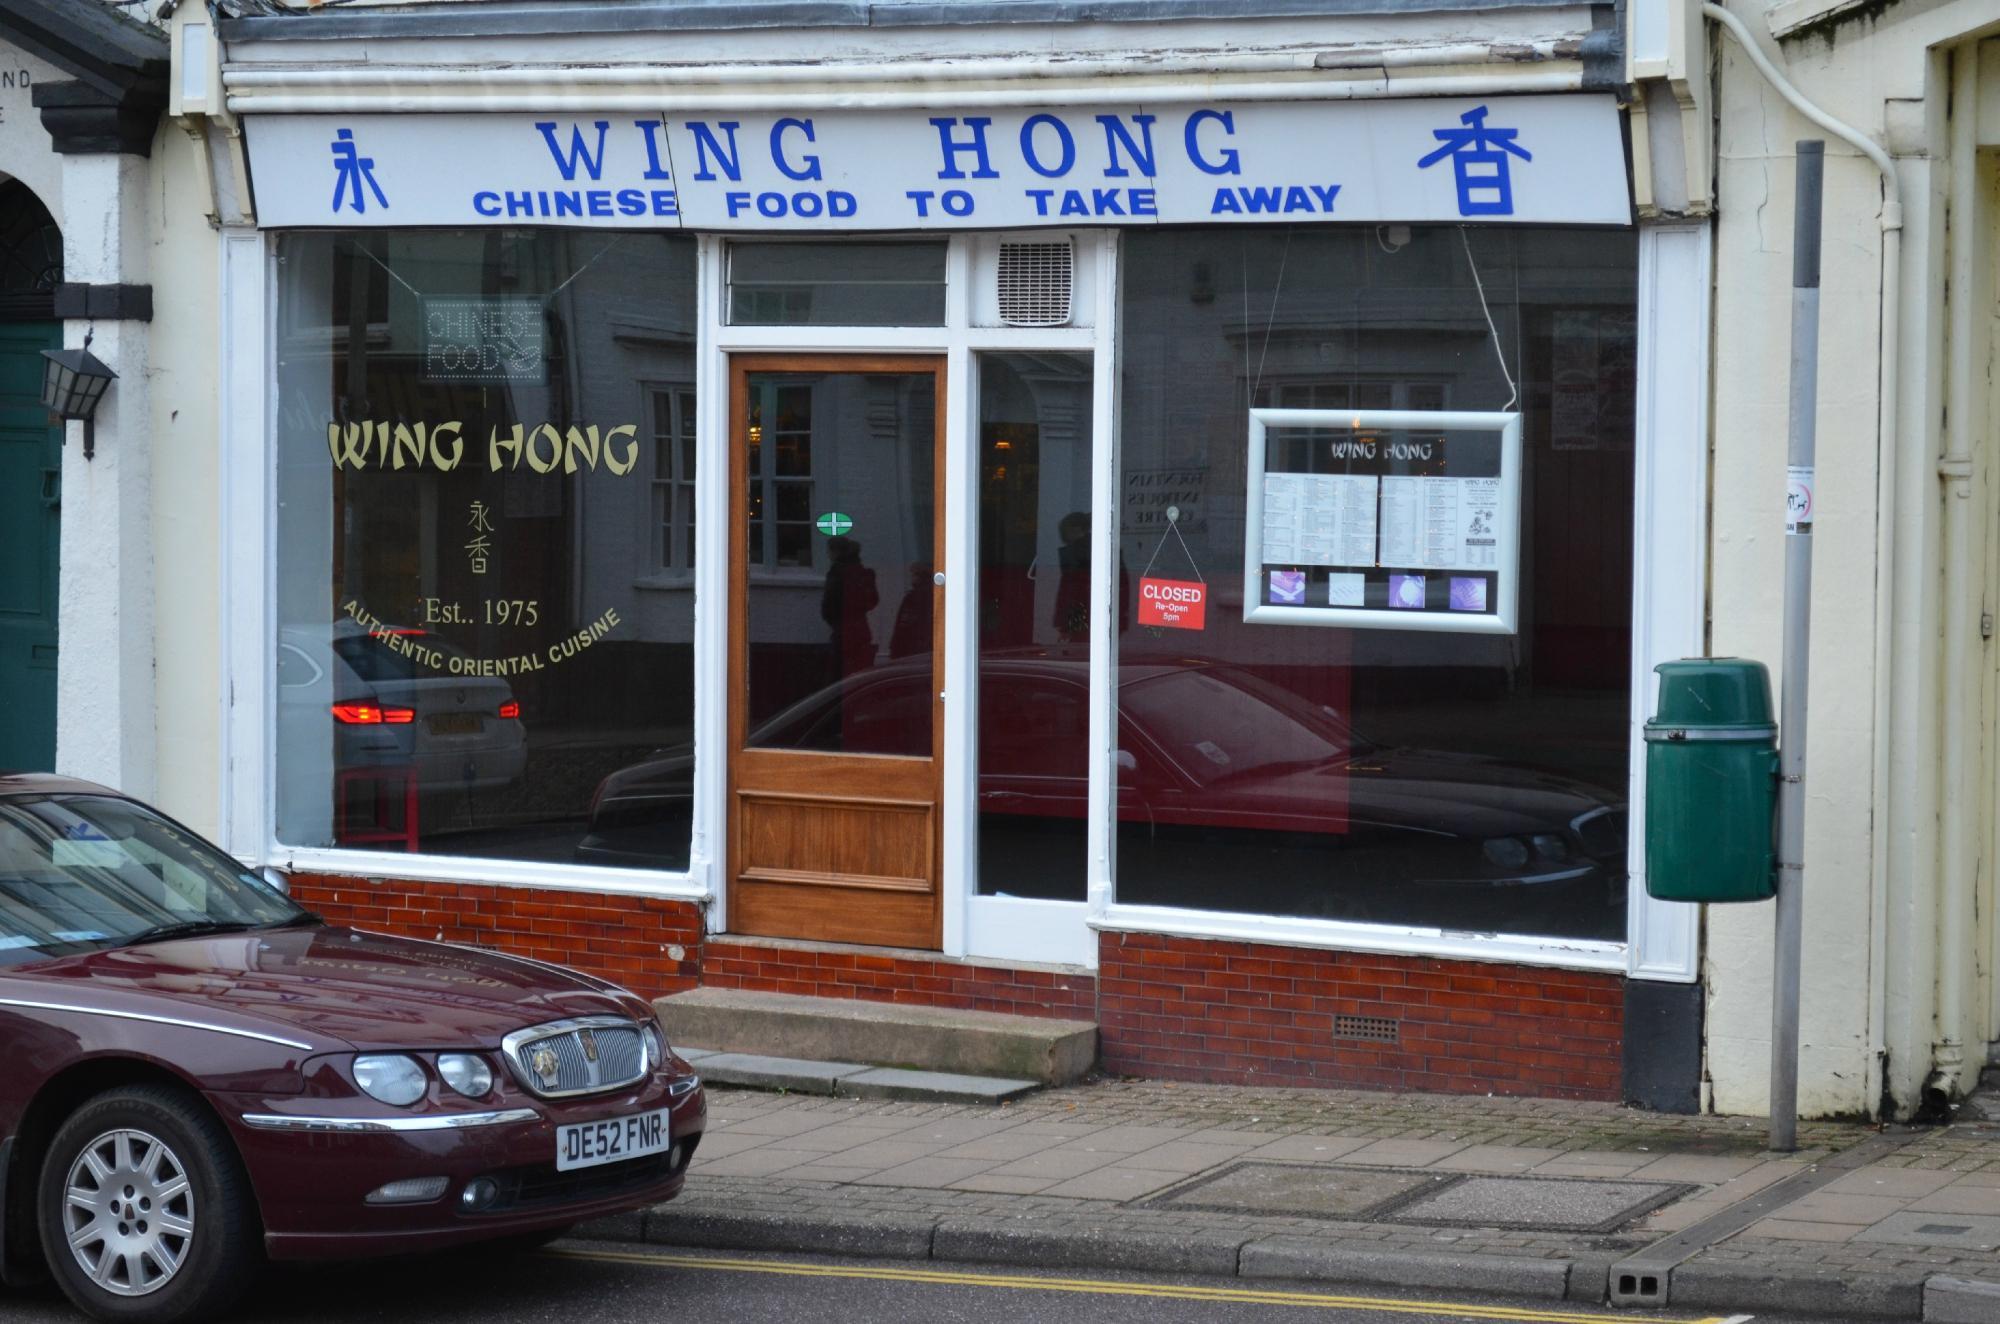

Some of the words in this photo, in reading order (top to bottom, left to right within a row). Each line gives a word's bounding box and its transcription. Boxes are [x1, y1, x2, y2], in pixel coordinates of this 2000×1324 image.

[535, 118, 822, 182] WING
[929, 109, 1241, 180] HONG
[1416, 104, 1533, 217] 香
[330, 128, 390, 214] 永
[473, 189, 677, 217] CHINESE
[725, 191, 858, 218] FOOD
[906, 189, 975, 217] TO
[1025, 188, 1158, 216] TAKE
[1210, 184, 1342, 214] AWAY
[426, 311, 542, 338] CHINESE
[427, 344, 500, 371] FOOD
[327, 420, 464, 472] WING
[489, 422, 639, 476] HONG
[1332, 442, 1377, 460] WING
[1384, 443, 1432, 460] HONG
[1143, 584, 1201, 603] CLOSED
[1155, 602, 1188, 613] Re-Open
[484, 599, 538, 626] 1975
[1163, 612, 1180, 622] 5pm
[343, 599, 442, 669] AUTHENTIC
[448, 653, 544, 677] ORIENTAL
[548, 607, 621, 663] CUISINE
[566, 1122, 621, 1162] DE52
[626, 1113, 661, 1151] FNR
